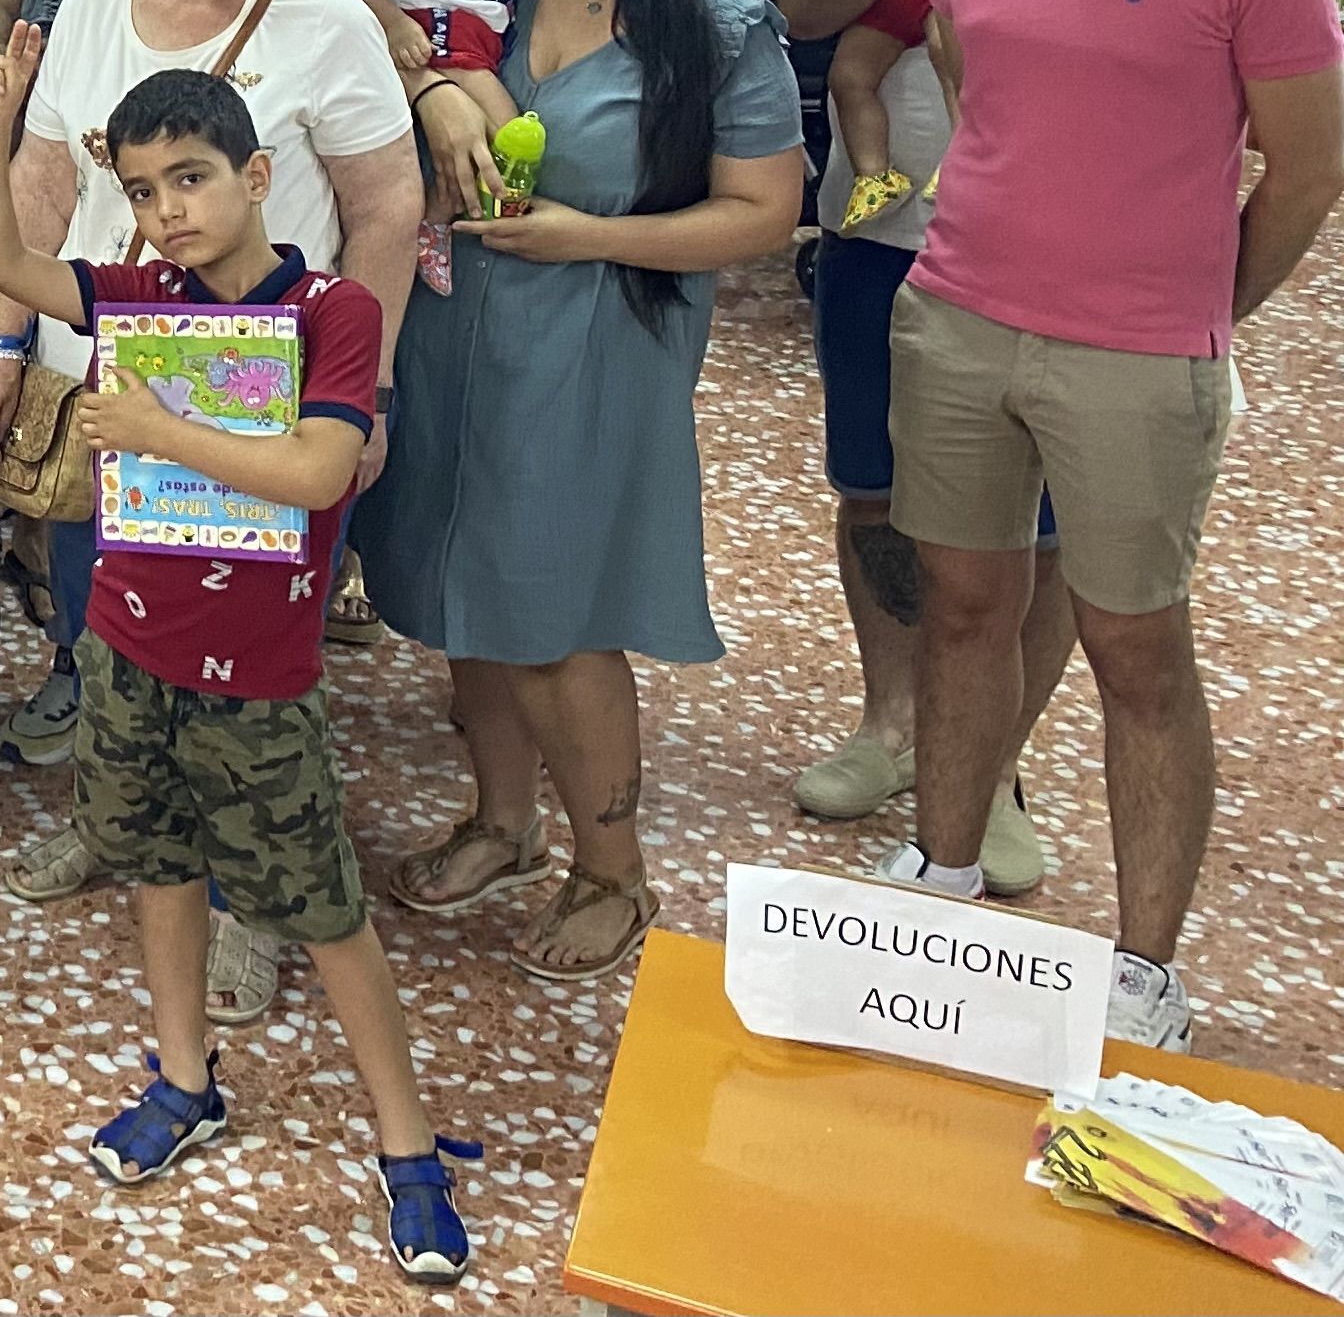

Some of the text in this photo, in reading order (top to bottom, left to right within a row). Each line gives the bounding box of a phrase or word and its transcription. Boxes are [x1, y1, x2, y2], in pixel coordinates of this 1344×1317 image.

[288, 570, 313, 602] K
[201, 655, 234, 682] N
[762, 903, 1074, 992] DEVOLUCIONES
[859, 987, 968, 1035] AQUÍ
